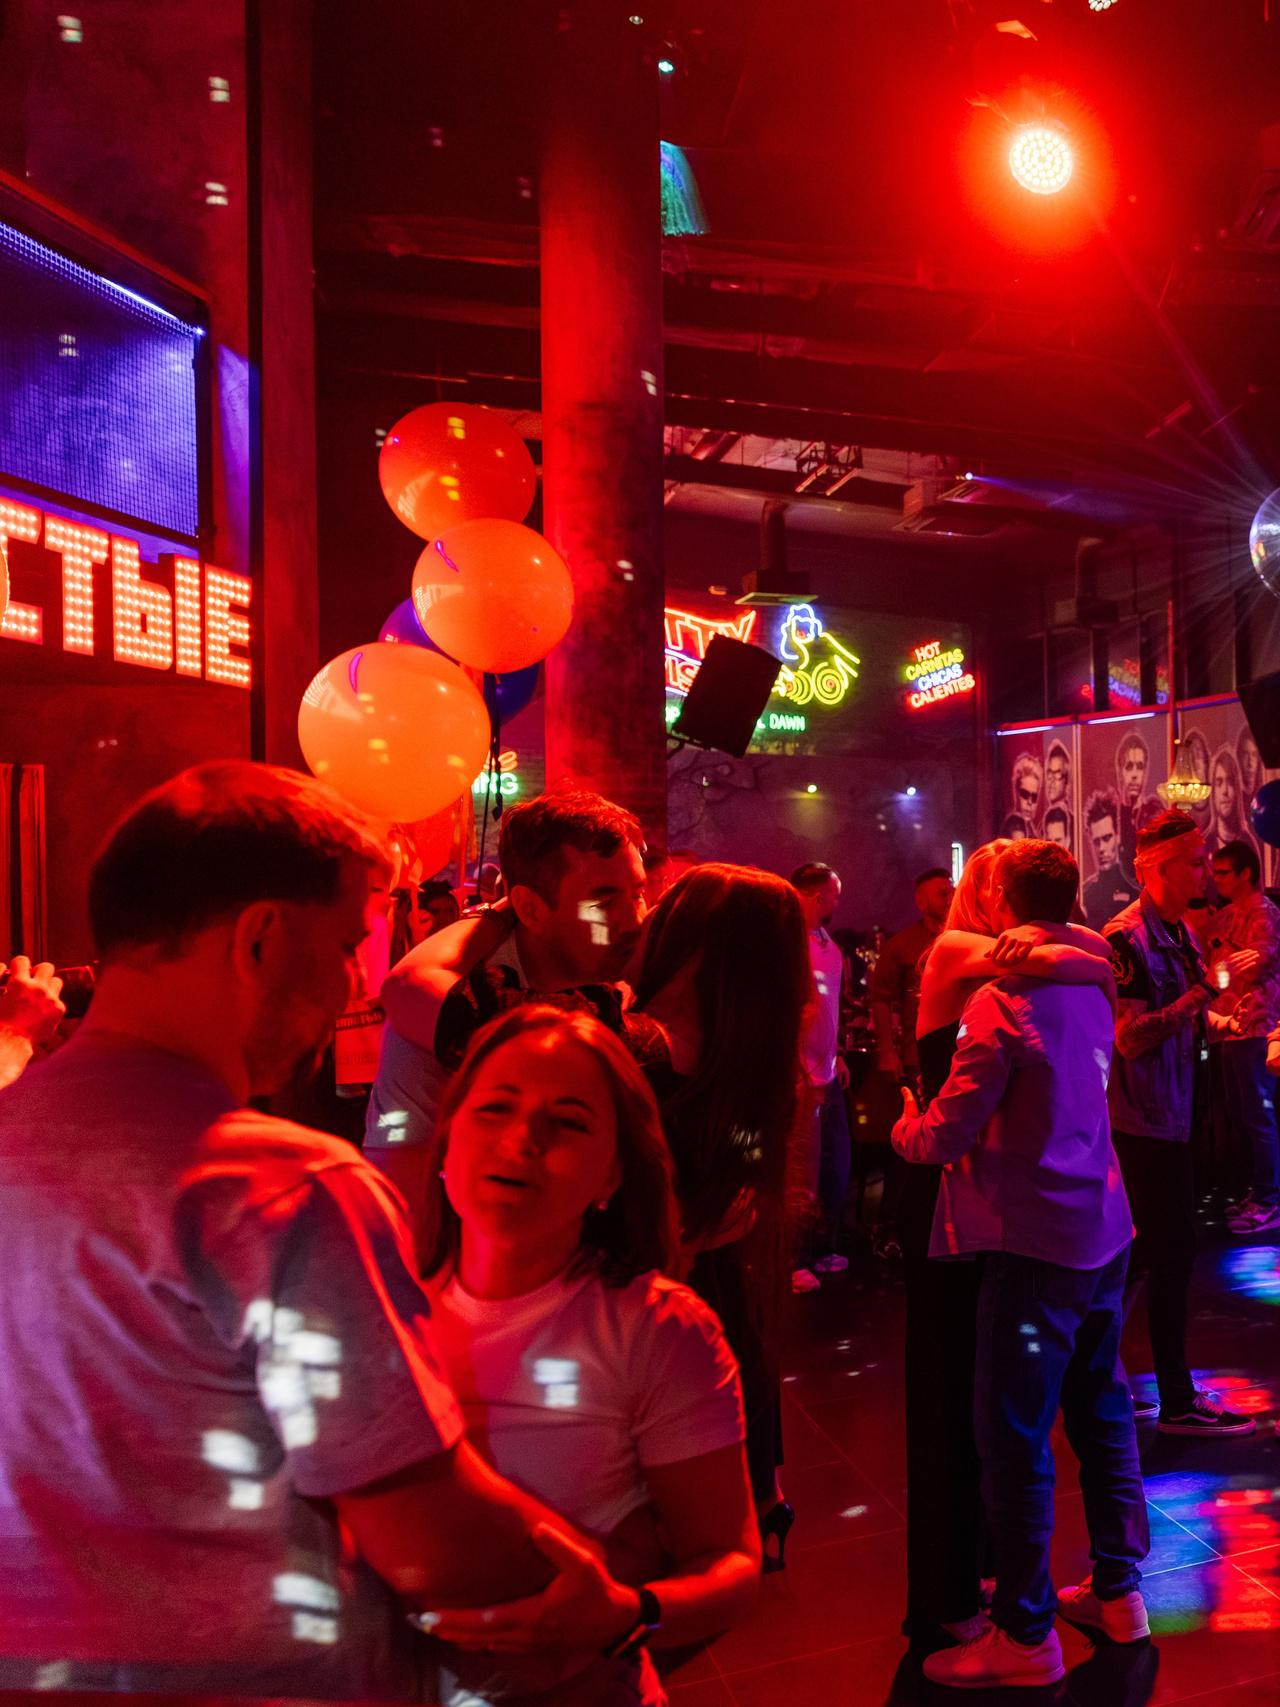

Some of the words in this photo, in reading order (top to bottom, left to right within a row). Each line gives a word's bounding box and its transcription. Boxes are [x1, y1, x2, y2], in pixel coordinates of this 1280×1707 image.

[914, 641, 940, 662] HOT
[905, 648, 965, 681] CARNITAS
[917, 663, 963, 691] CHICAS
[910, 674, 975, 708] CALIENTES
[769, 713, 806, 731] DAWN
[474, 771, 519, 794] ING
